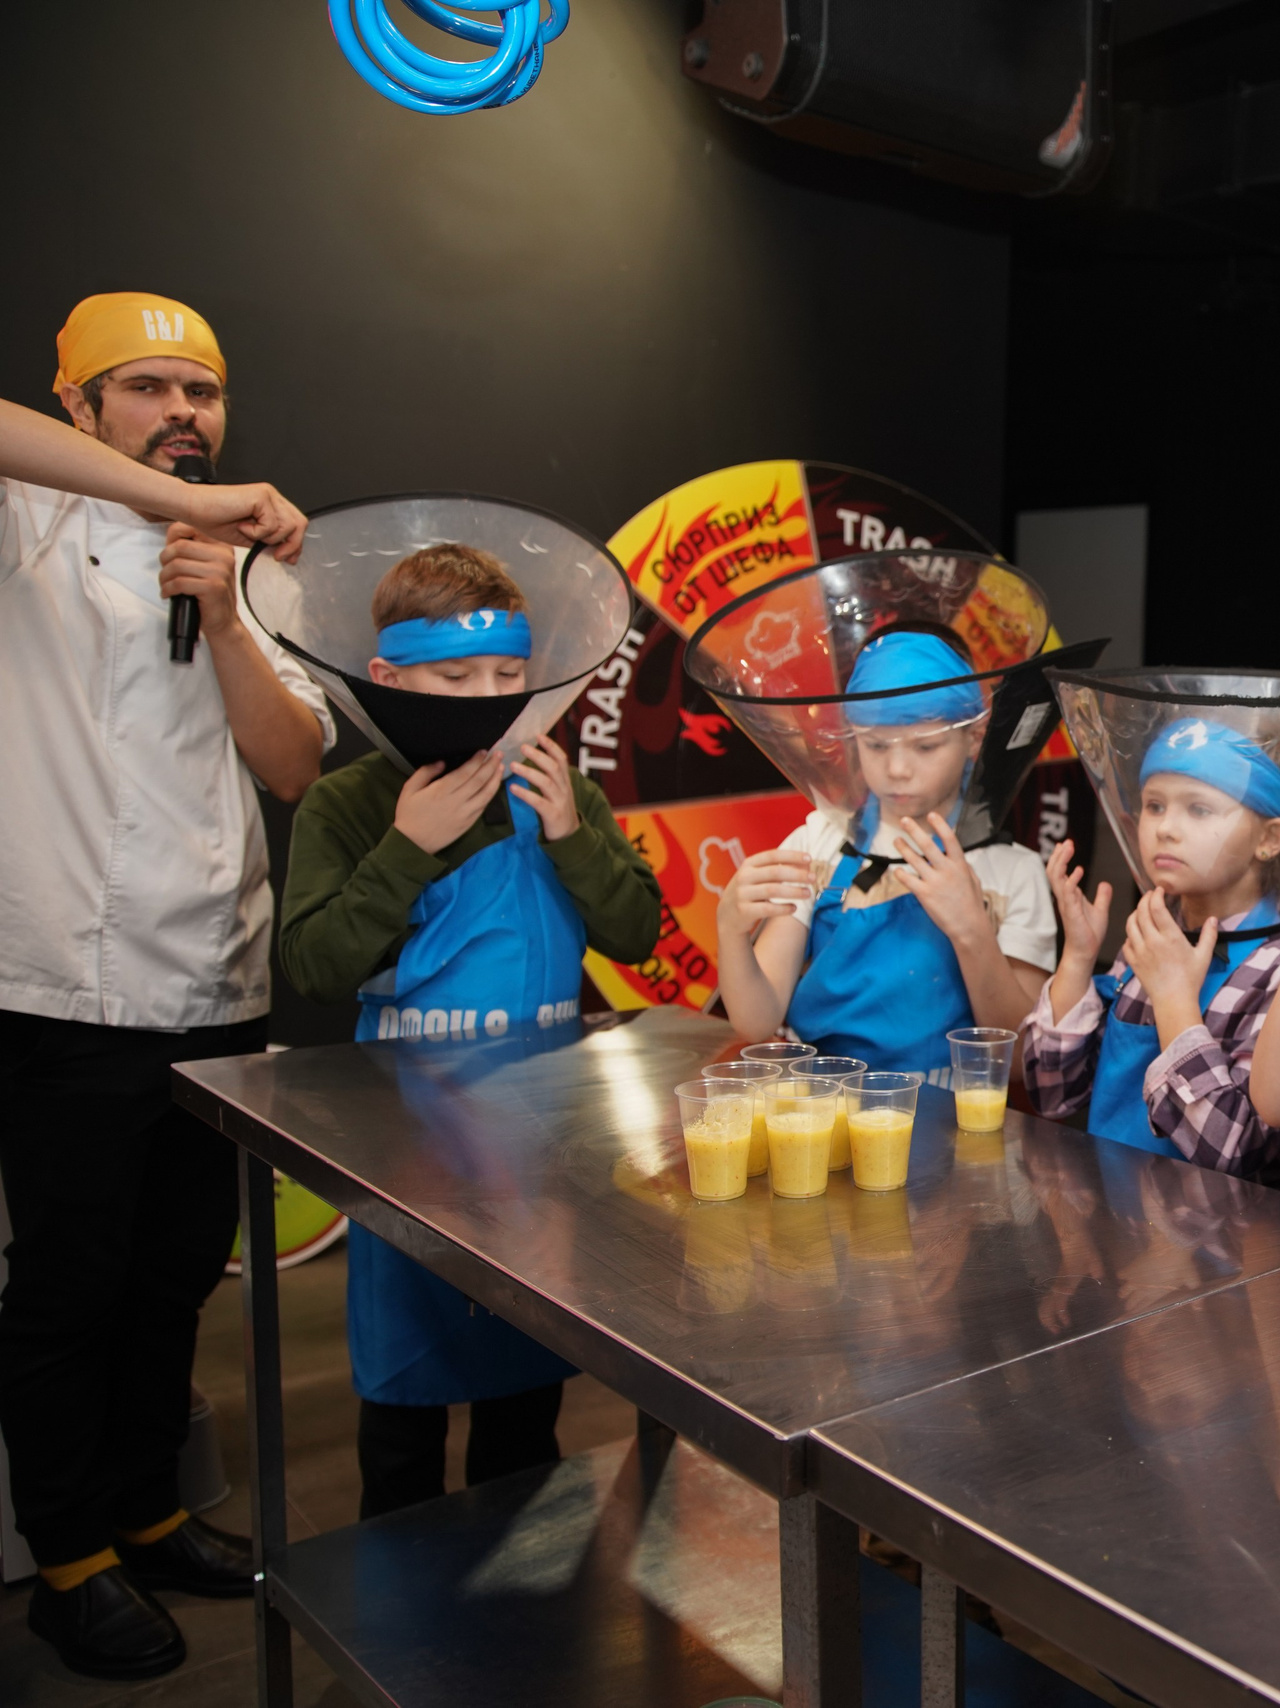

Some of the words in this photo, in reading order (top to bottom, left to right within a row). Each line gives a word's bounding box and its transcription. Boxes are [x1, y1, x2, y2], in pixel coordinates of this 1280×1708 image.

[652, 502, 780, 583] СЮРПРИЗ
[674, 576, 707, 614] ОТ
[707, 535, 795, 587] ШЕФА
[836, 507, 958, 587] TRASH
